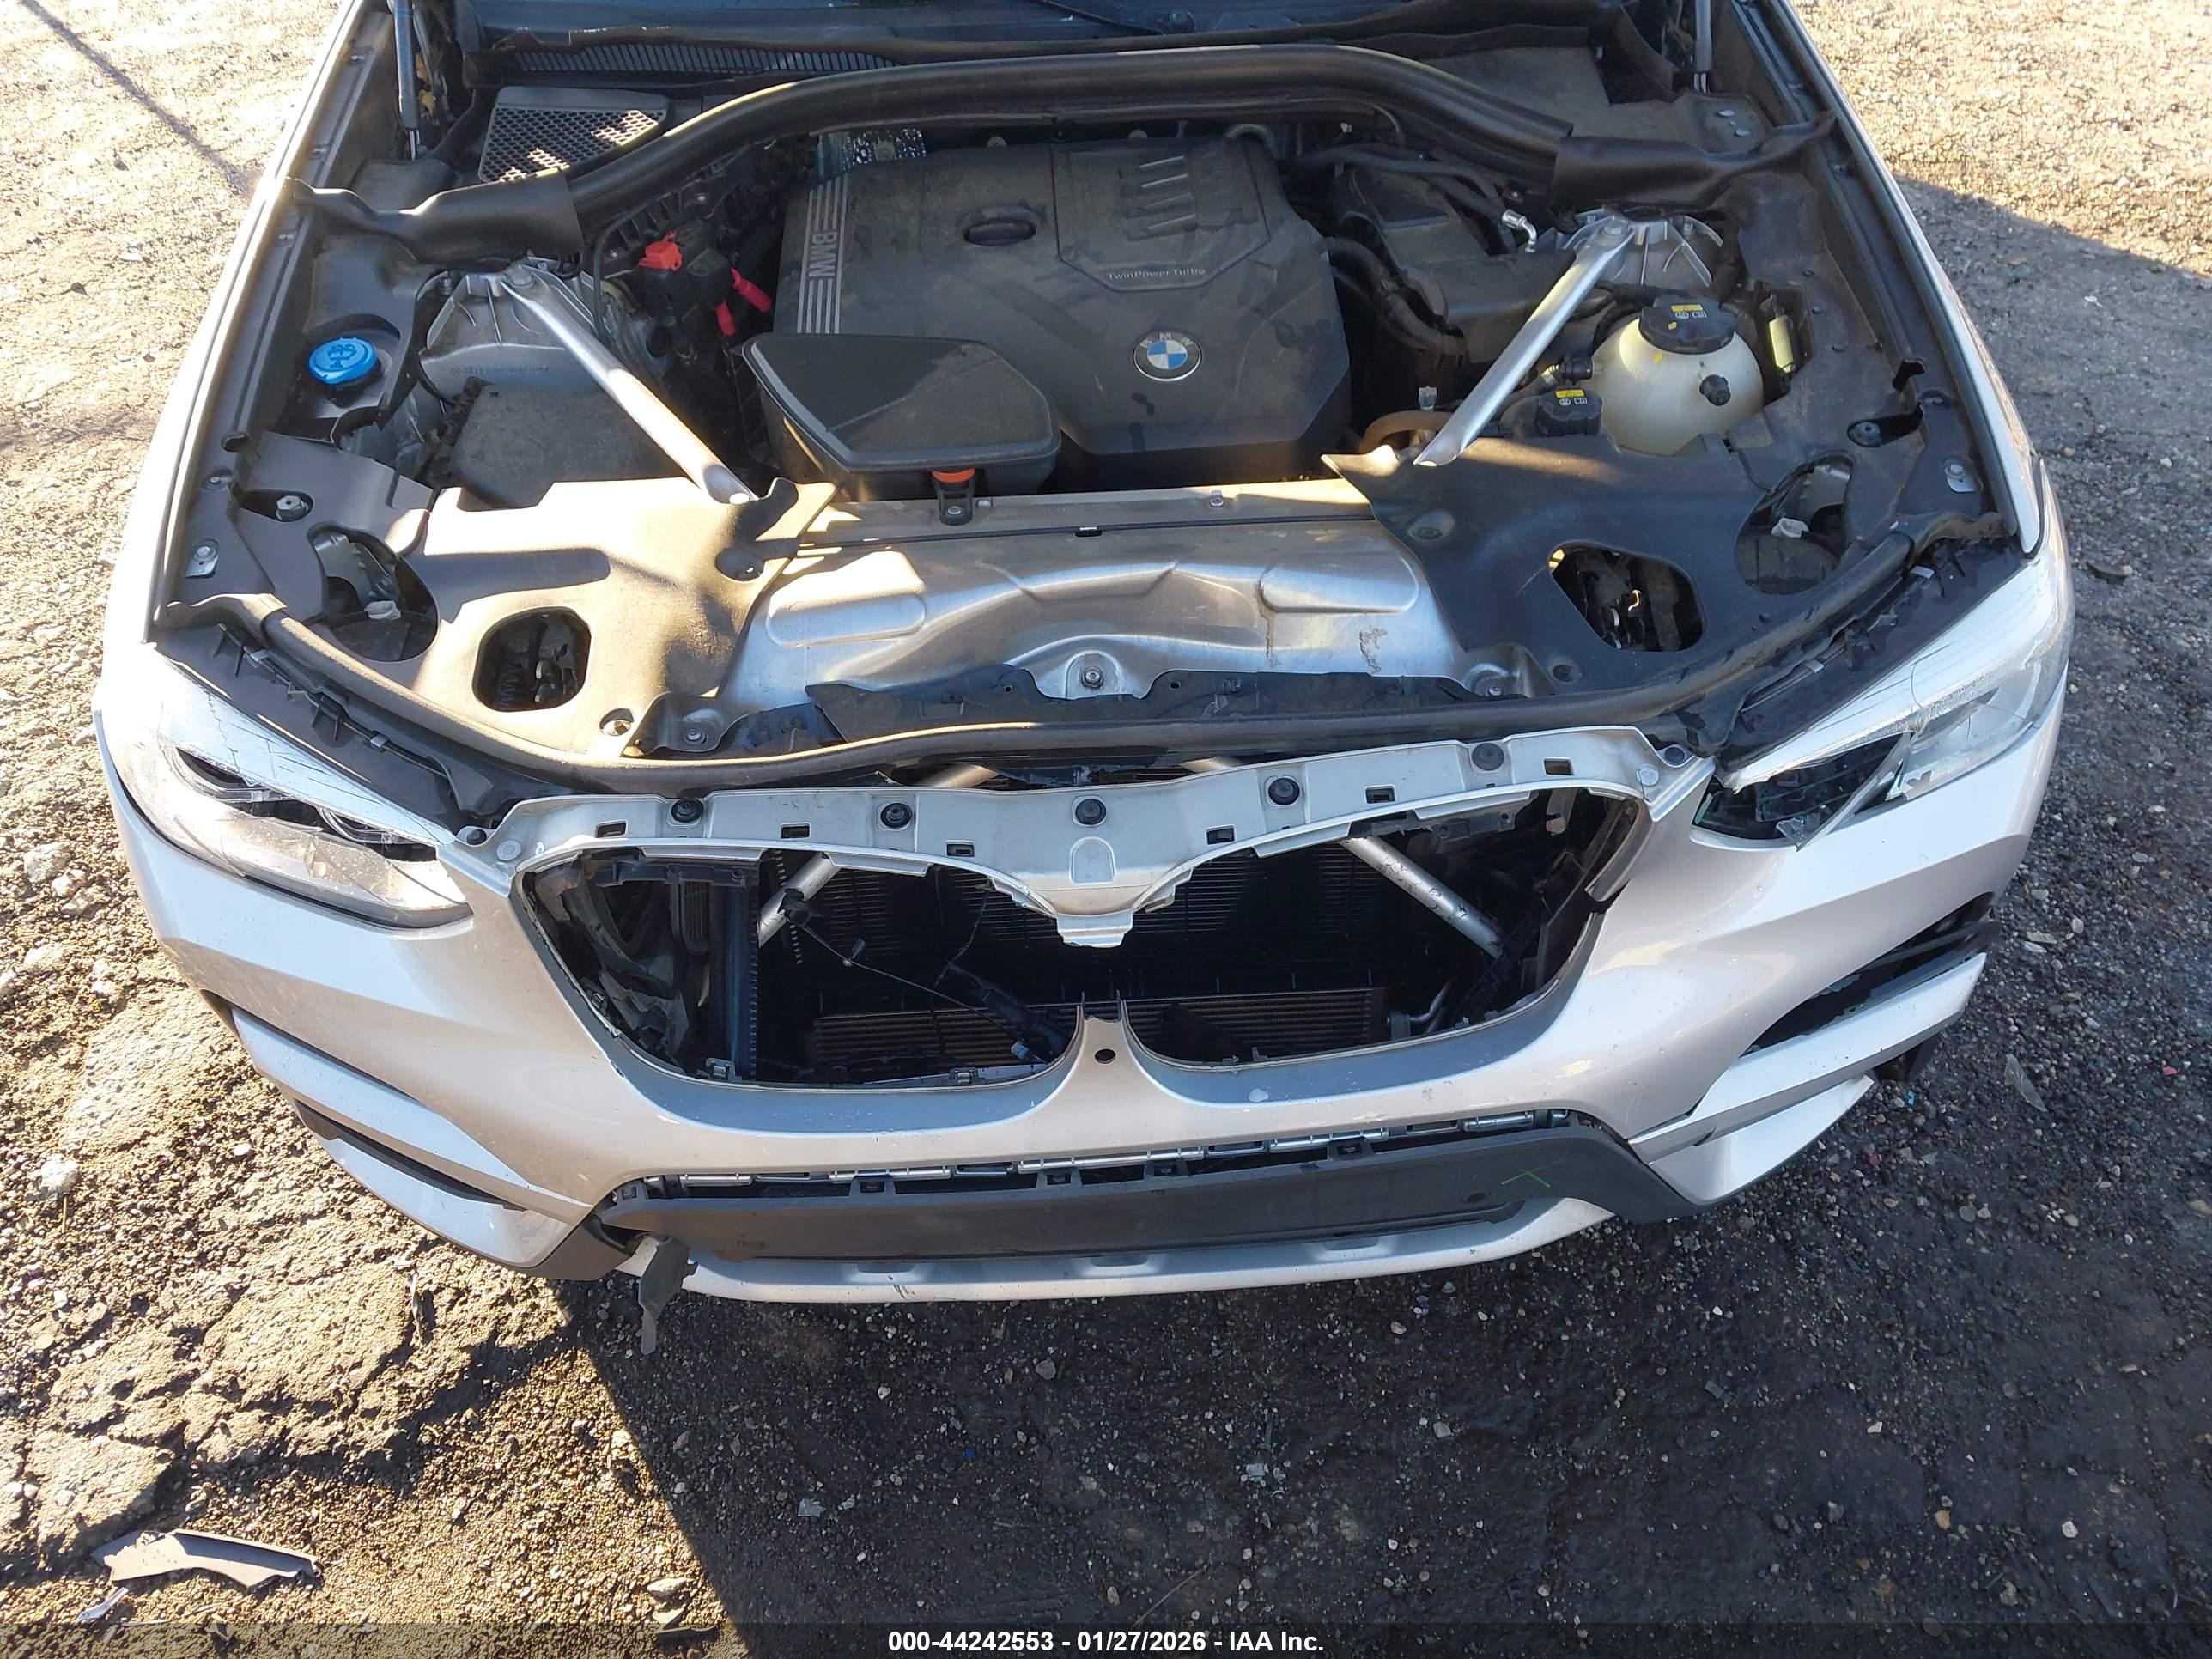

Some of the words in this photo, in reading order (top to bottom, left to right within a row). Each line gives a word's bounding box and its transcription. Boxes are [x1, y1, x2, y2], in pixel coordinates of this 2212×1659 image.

[809, 231, 838, 276] BMW
[1107, 269, 1169, 280] TwinPower
[1174, 267, 1206, 276] Turbo
[1139, 332, 1194, 349] BMW
